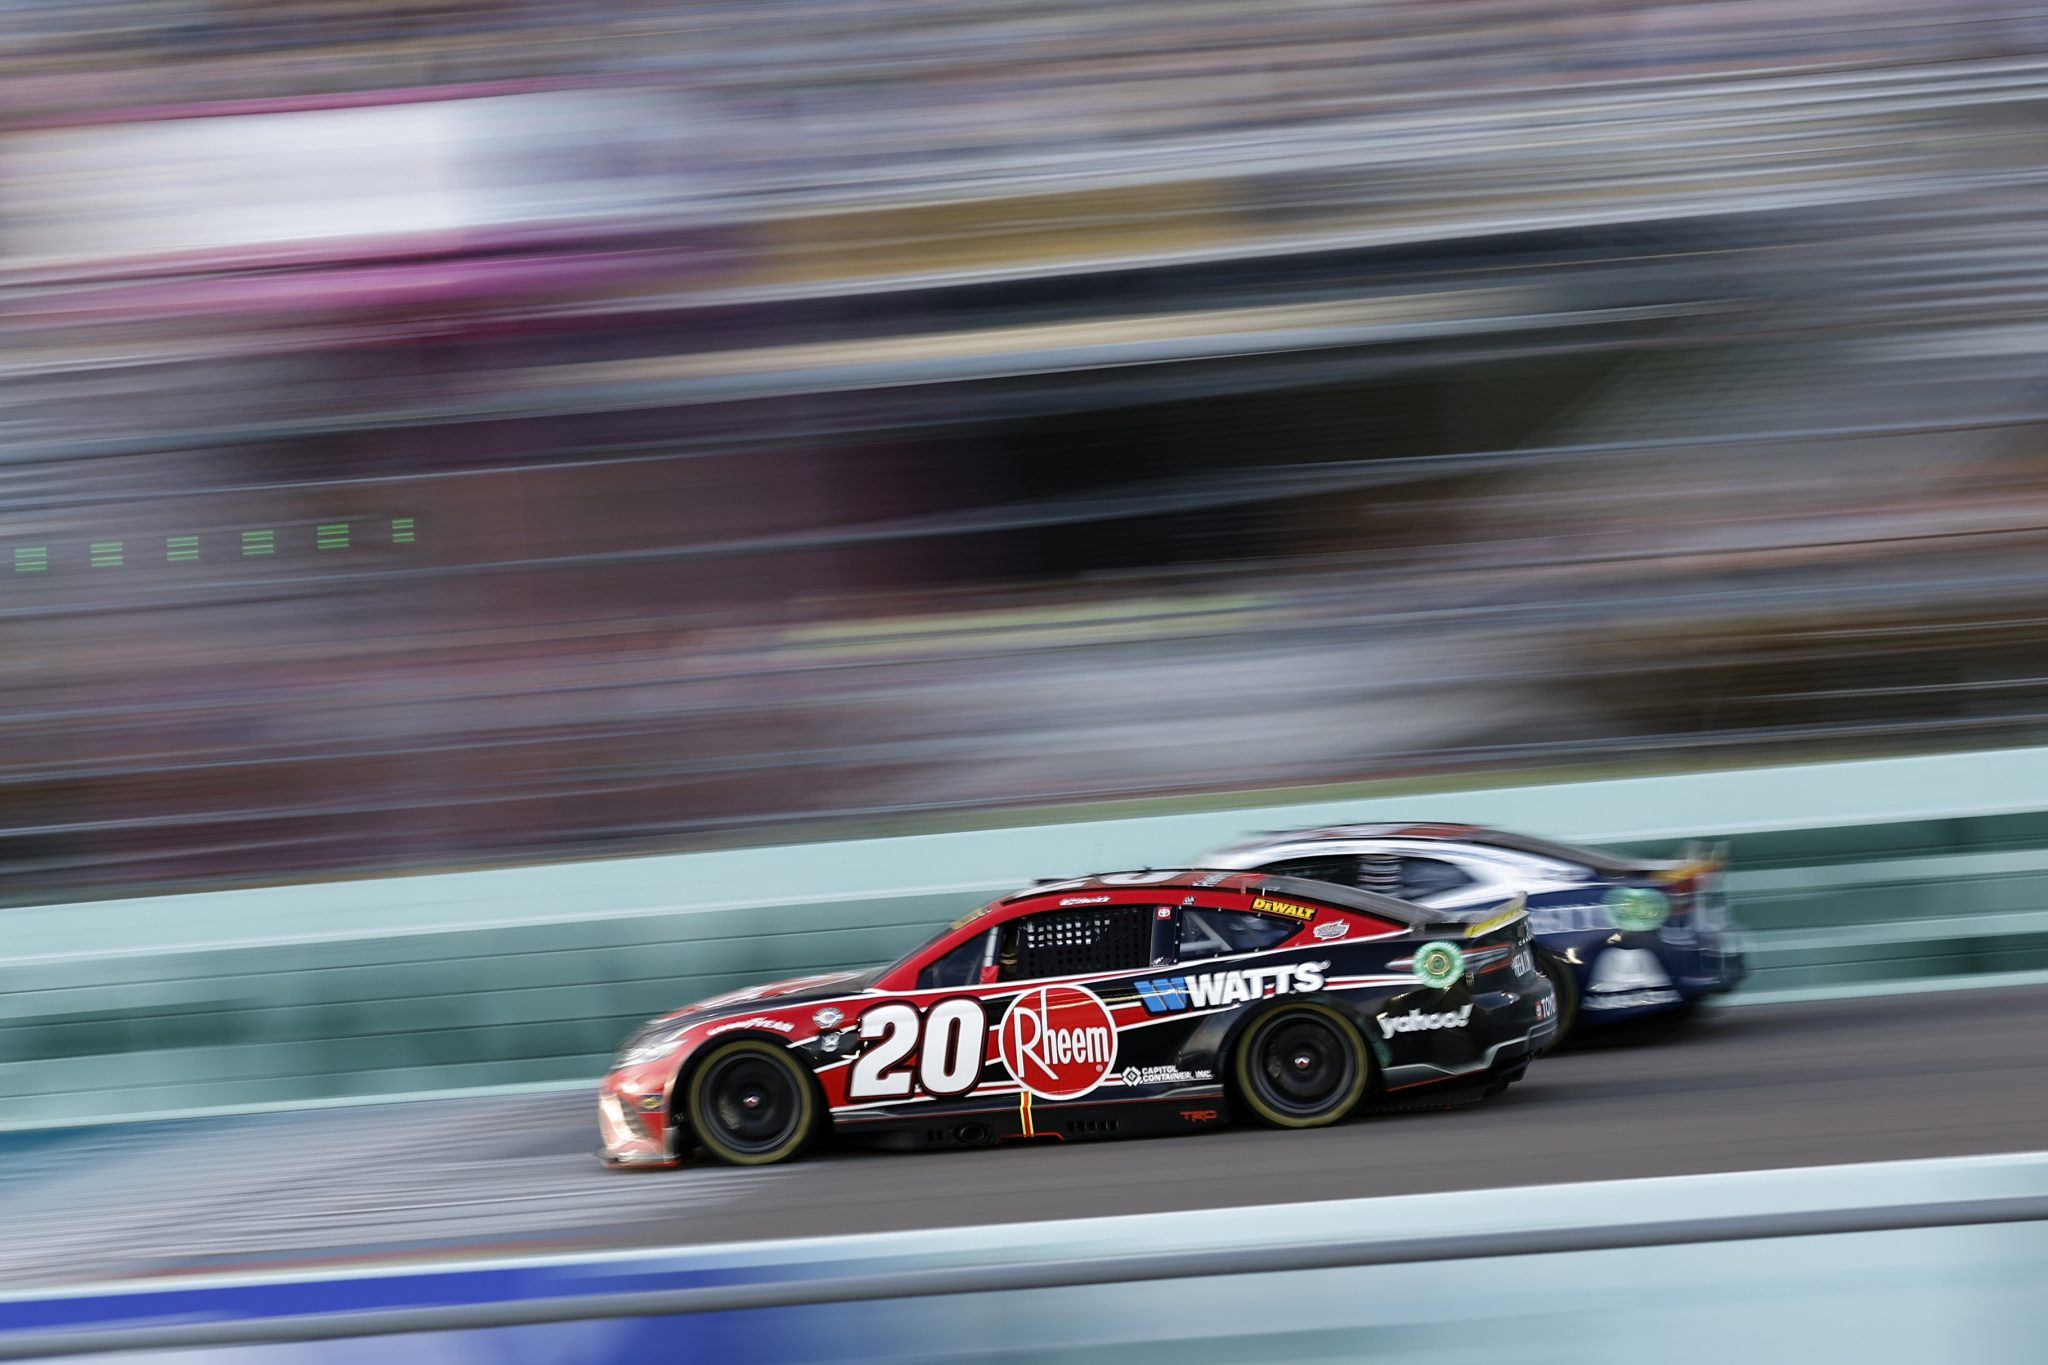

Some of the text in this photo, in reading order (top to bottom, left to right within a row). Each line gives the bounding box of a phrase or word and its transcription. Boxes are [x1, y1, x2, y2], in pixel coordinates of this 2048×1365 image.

[1252, 898, 1316, 921] DEWALT
[1184, 962, 1325, 1008] WATTS
[1013, 989, 1110, 1080] Rheem
[850, 999, 985, 1097] 20
[1142, 1065, 1179, 1075] CAPITOL
[1195, 1070, 1214, 1080] INC.
[1180, 1110, 1217, 1122] TRD
